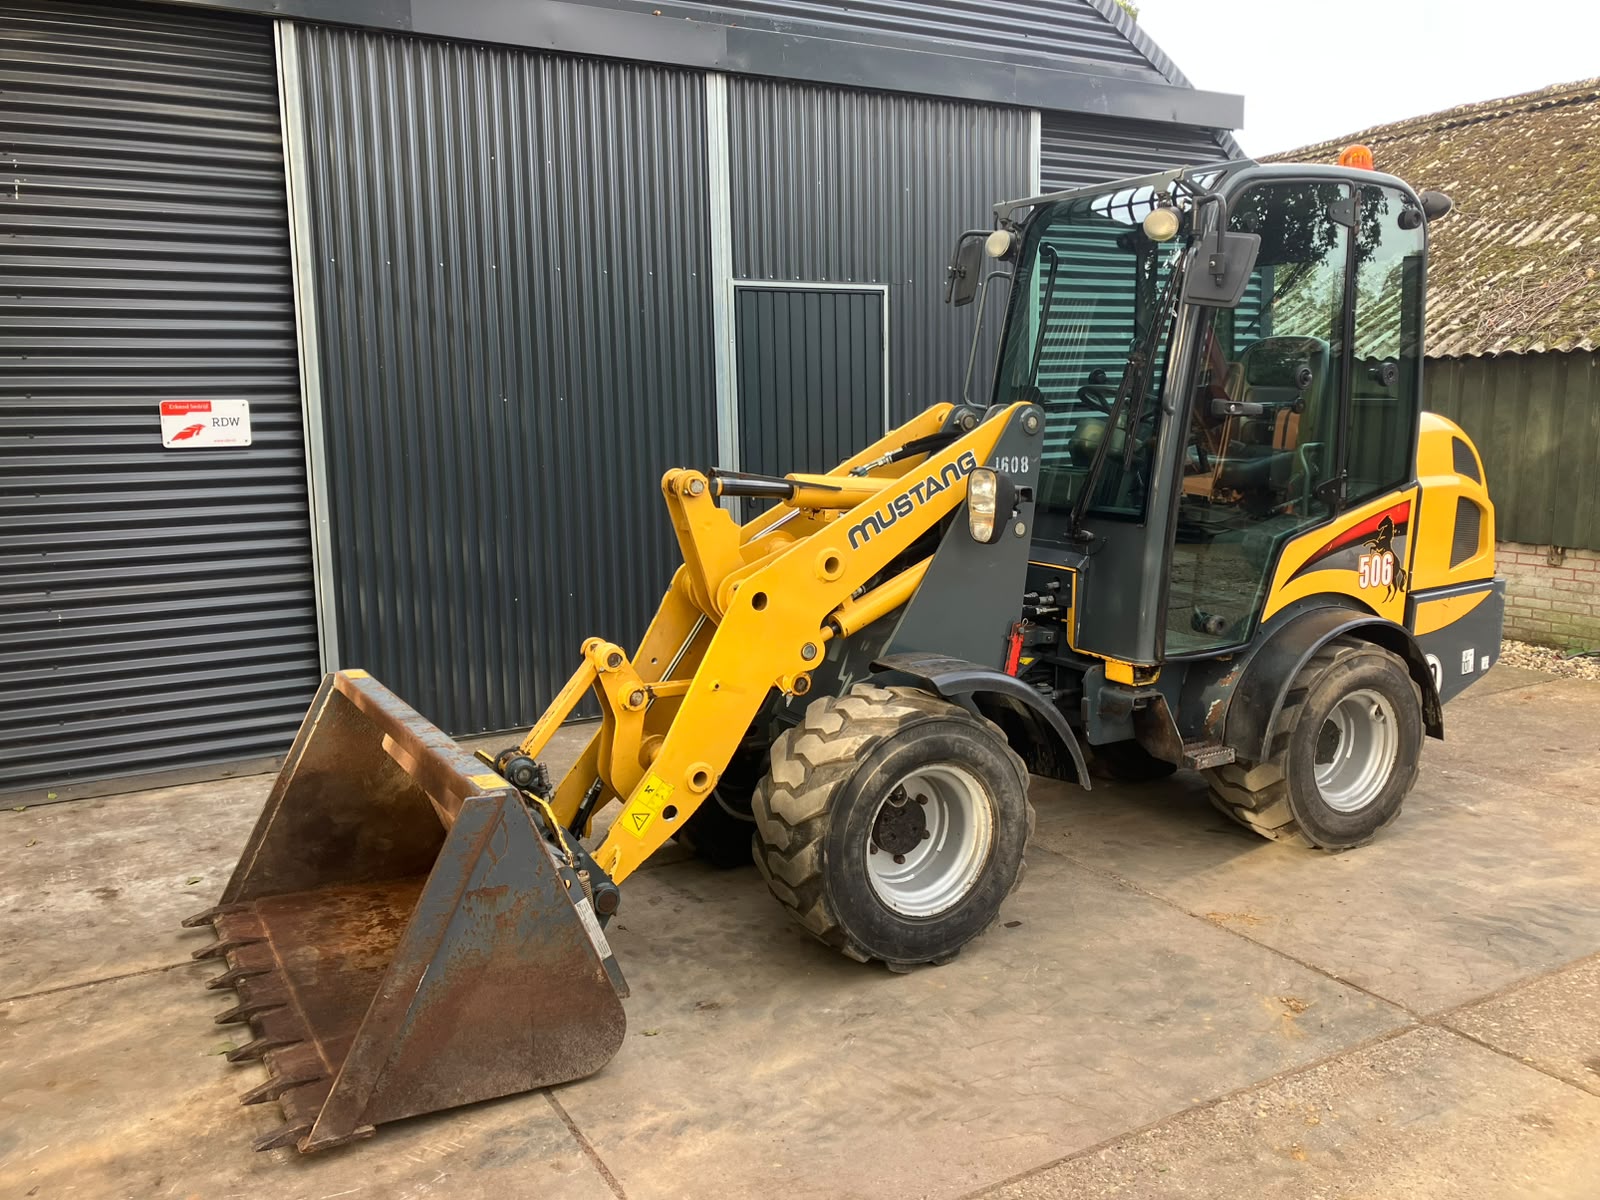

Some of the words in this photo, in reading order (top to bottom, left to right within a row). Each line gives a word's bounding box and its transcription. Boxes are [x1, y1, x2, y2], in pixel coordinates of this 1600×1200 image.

[211, 416, 241, 428] RDW
[847, 450, 977, 550] MUSTANG
[1358, 550, 1394, 589] 506
